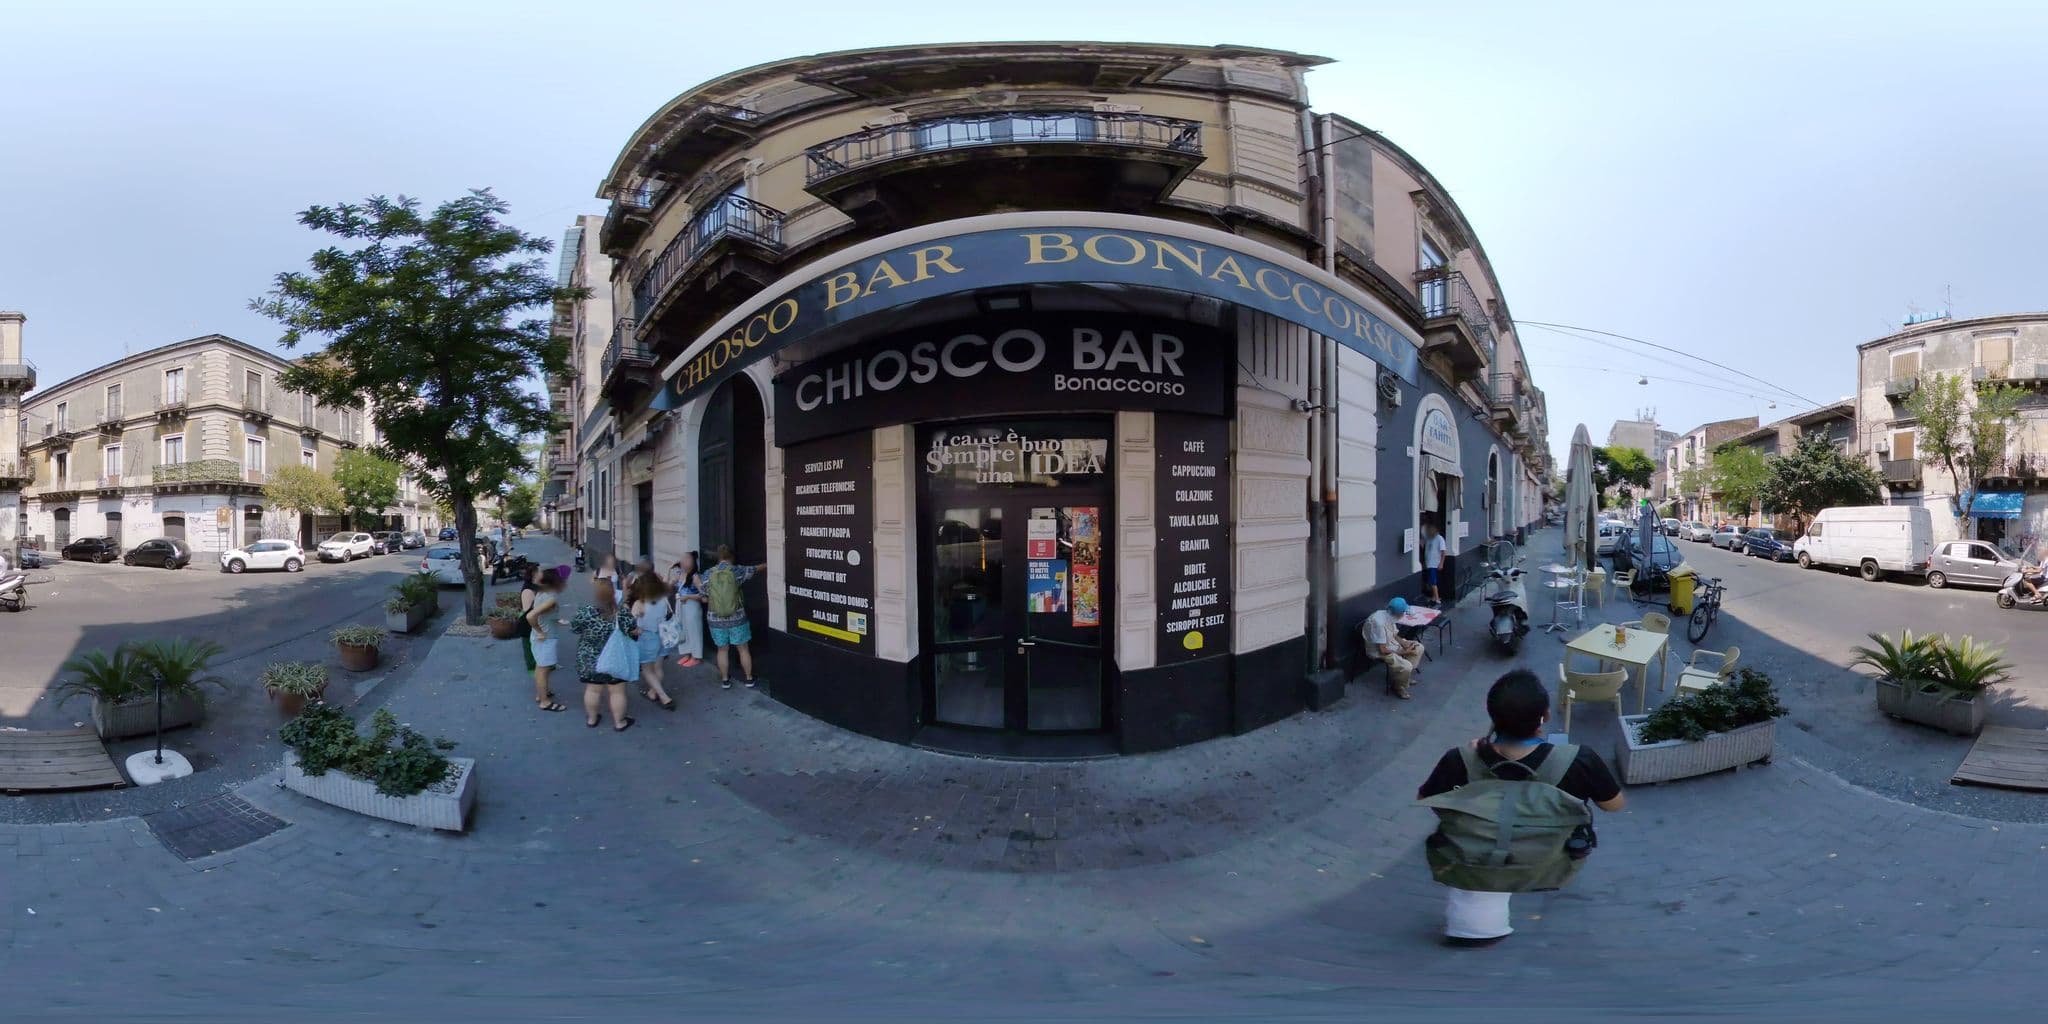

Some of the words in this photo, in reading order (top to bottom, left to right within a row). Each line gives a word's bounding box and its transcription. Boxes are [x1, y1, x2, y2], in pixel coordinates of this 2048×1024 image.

[676, 298, 799, 395] CHIOSCO
[824, 245, 965, 311] BAR
[1020, 233, 1404, 363] BONACCORSO
[796, 328, 1046, 411] CHIOSCO
[1073, 327, 1185, 377] BAR
[1054, 374, 1185, 396] Bonaccorso
[1007, 428, 1018, 444] è
[805, 462, 823, 473] SERVIZI
[824, 460, 832, 471] LIS
[833, 459, 844, 470] PAY
[926, 447, 1015, 474] Sempre
[1033, 453, 1103, 475] IDEA
[976, 470, 1015, 483] una
[1172, 465, 1216, 477] CAPPUCCINO
[796, 484, 820, 495] RICARICHE
[821, 481, 855, 493] TELEFONICHE
[1175, 490, 1213, 502] COLAZIONE
[797, 505, 823, 515] PAGAMENTI
[825, 504, 855, 515] BOLLETTINI
[1169, 515, 1196, 528] TAVOLA
[1197, 514, 1219, 526] CALDA
[800, 527, 827, 537] PAGAMENTI
[1180, 539, 1209, 552] GRANITA
[806, 548, 832, 560] FOTOCOPIE
[833, 550, 844, 560] FAX
[1184, 563, 1206, 576] BIBITE
[1173, 579, 1210, 593] ALCOLICHE
[1212, 577, 1217, 588] E
[813, 590, 829, 602] CONTO
[1172, 593, 1218, 610] ANALCOLICHE
[813, 609, 825, 620] SALA
[826, 612, 839, 624] SLOT
[1166, 618, 1199, 633] SCIROPPI
[1200, 617, 1205, 628] E
[1206, 614, 1225, 627] SELTZ
